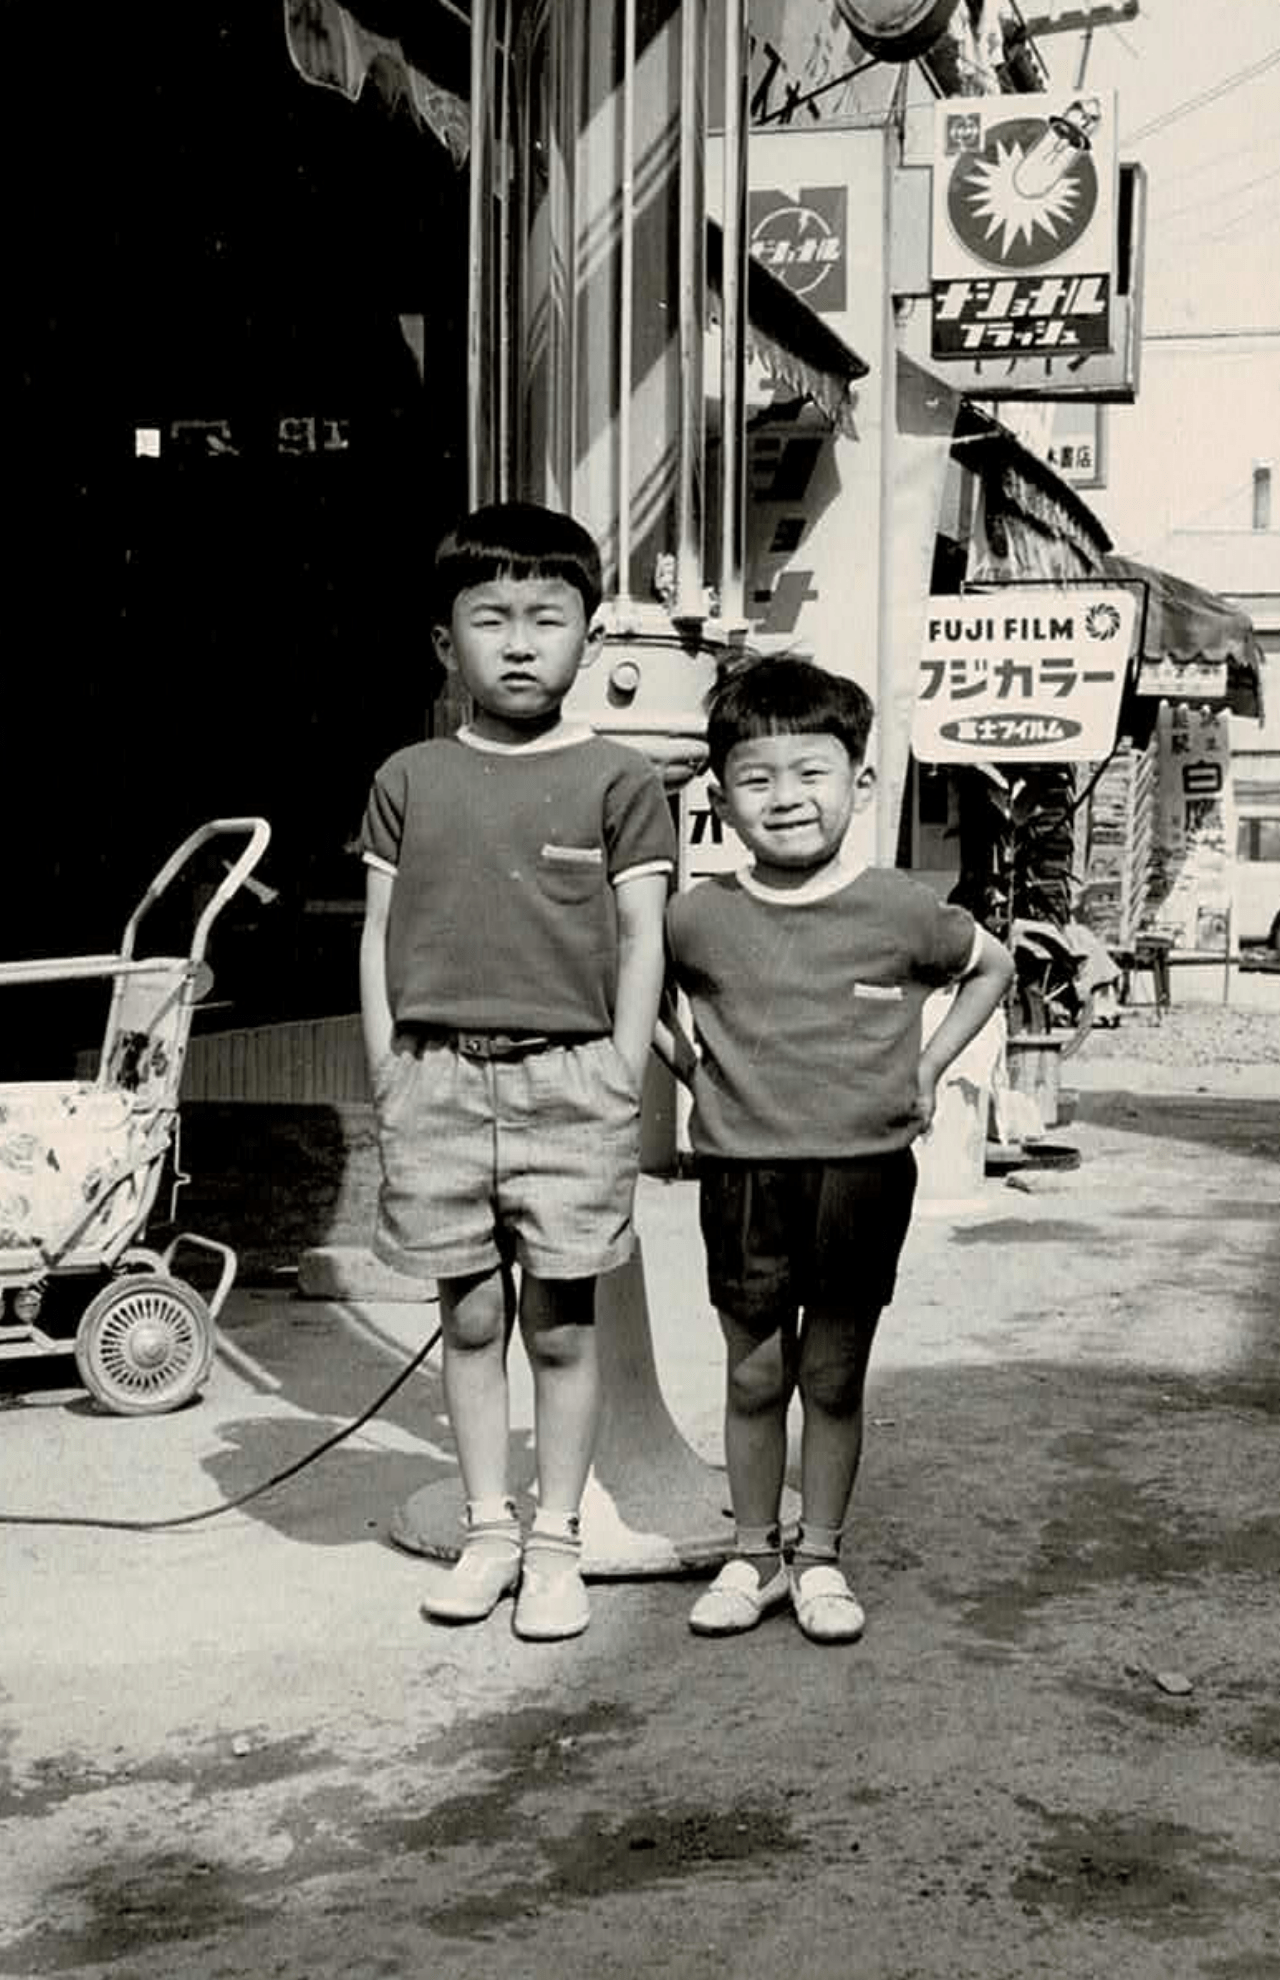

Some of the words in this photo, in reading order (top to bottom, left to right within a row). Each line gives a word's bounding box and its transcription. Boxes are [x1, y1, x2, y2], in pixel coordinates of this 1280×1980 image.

[936, 277, 1105, 320] ナショナル
[960, 320, 1081, 348] フラッシュ
[929, 618, 993, 642] FUJI
[1004, 618, 1074, 641] FILM
[919, 658, 1115, 700] フジカラー
